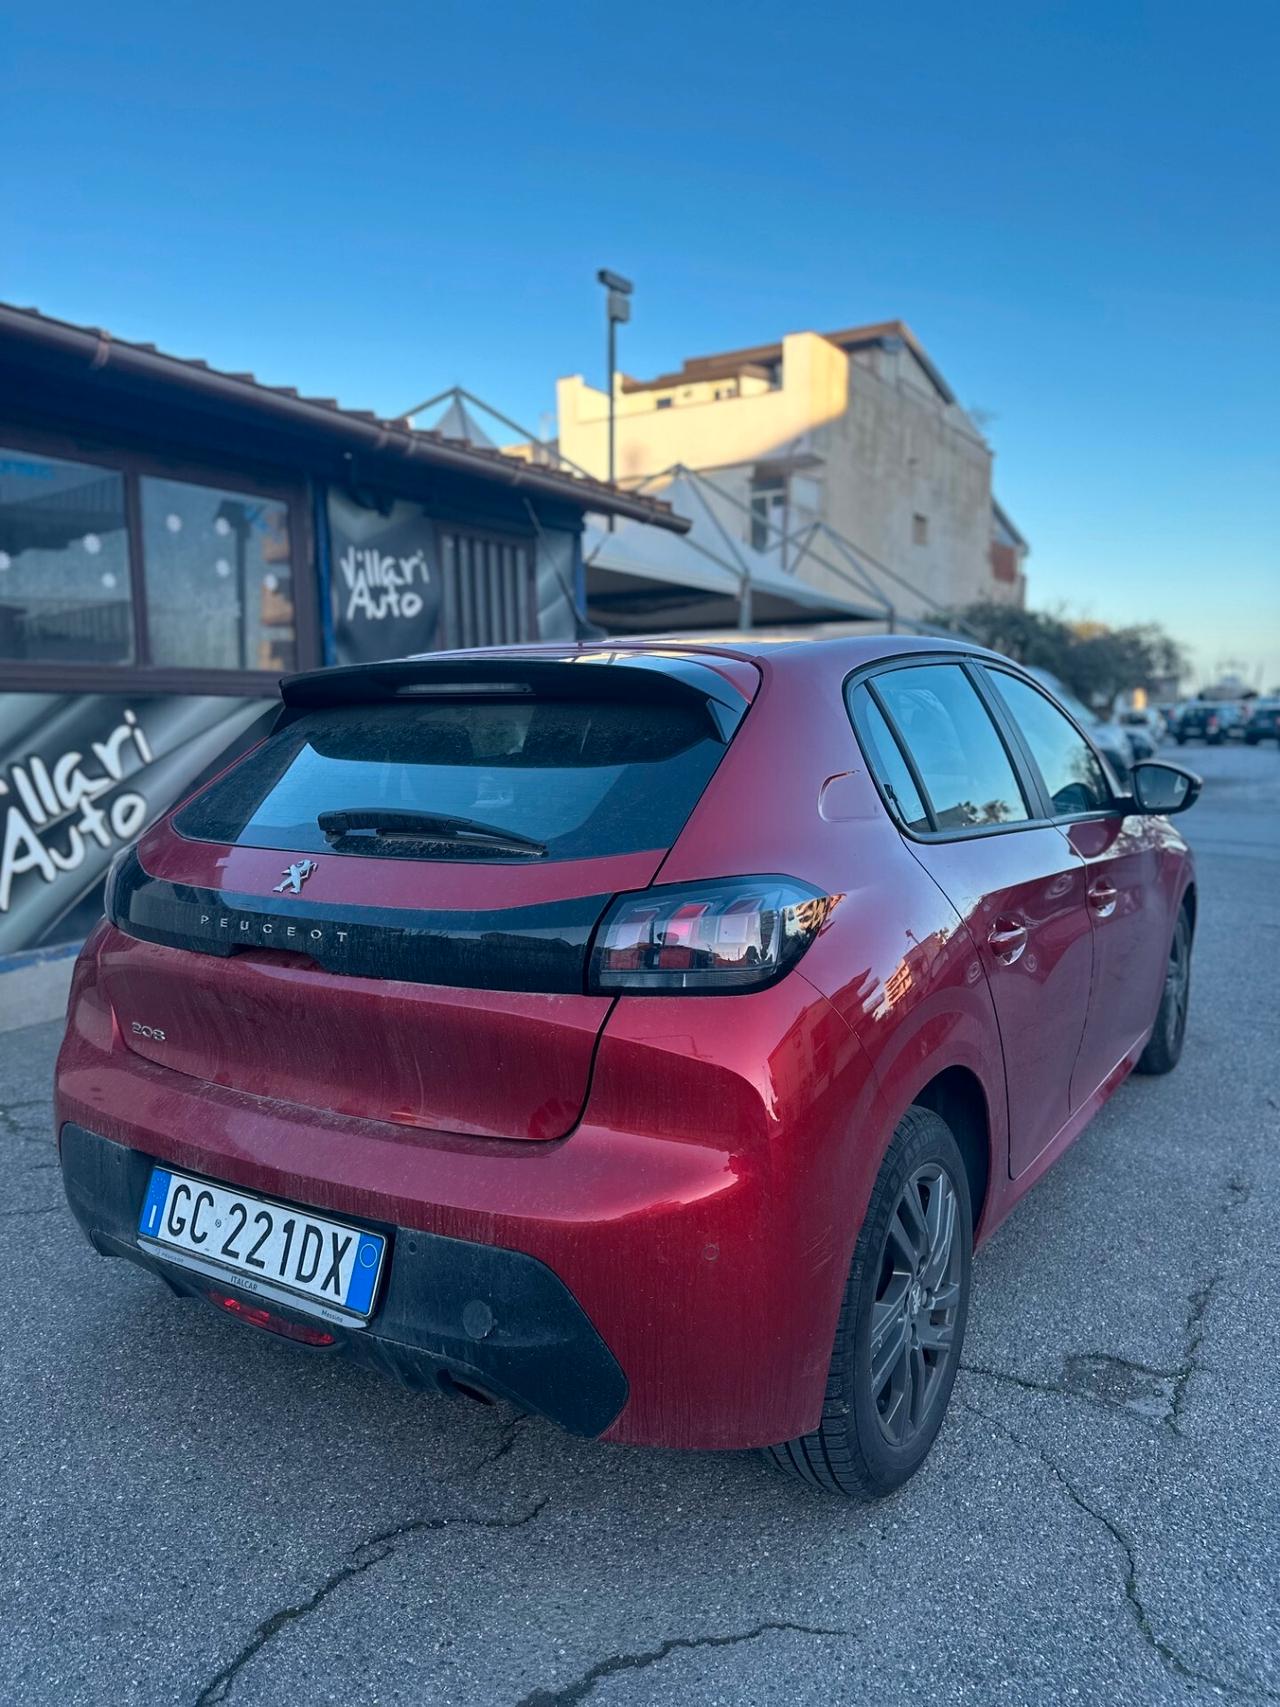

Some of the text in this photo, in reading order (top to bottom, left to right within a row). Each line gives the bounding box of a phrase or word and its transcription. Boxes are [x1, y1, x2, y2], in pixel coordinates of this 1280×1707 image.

[340, 546, 430, 588] Villari
[346, 568, 423, 622] Auto
[0, 709, 152, 825] illari
[0, 792, 147, 911] Auto
[200, 914, 348, 943] PEUGEOT
[131, 1021, 167, 1042] 208
[230, 1275, 259, 1292] ITALCAR
